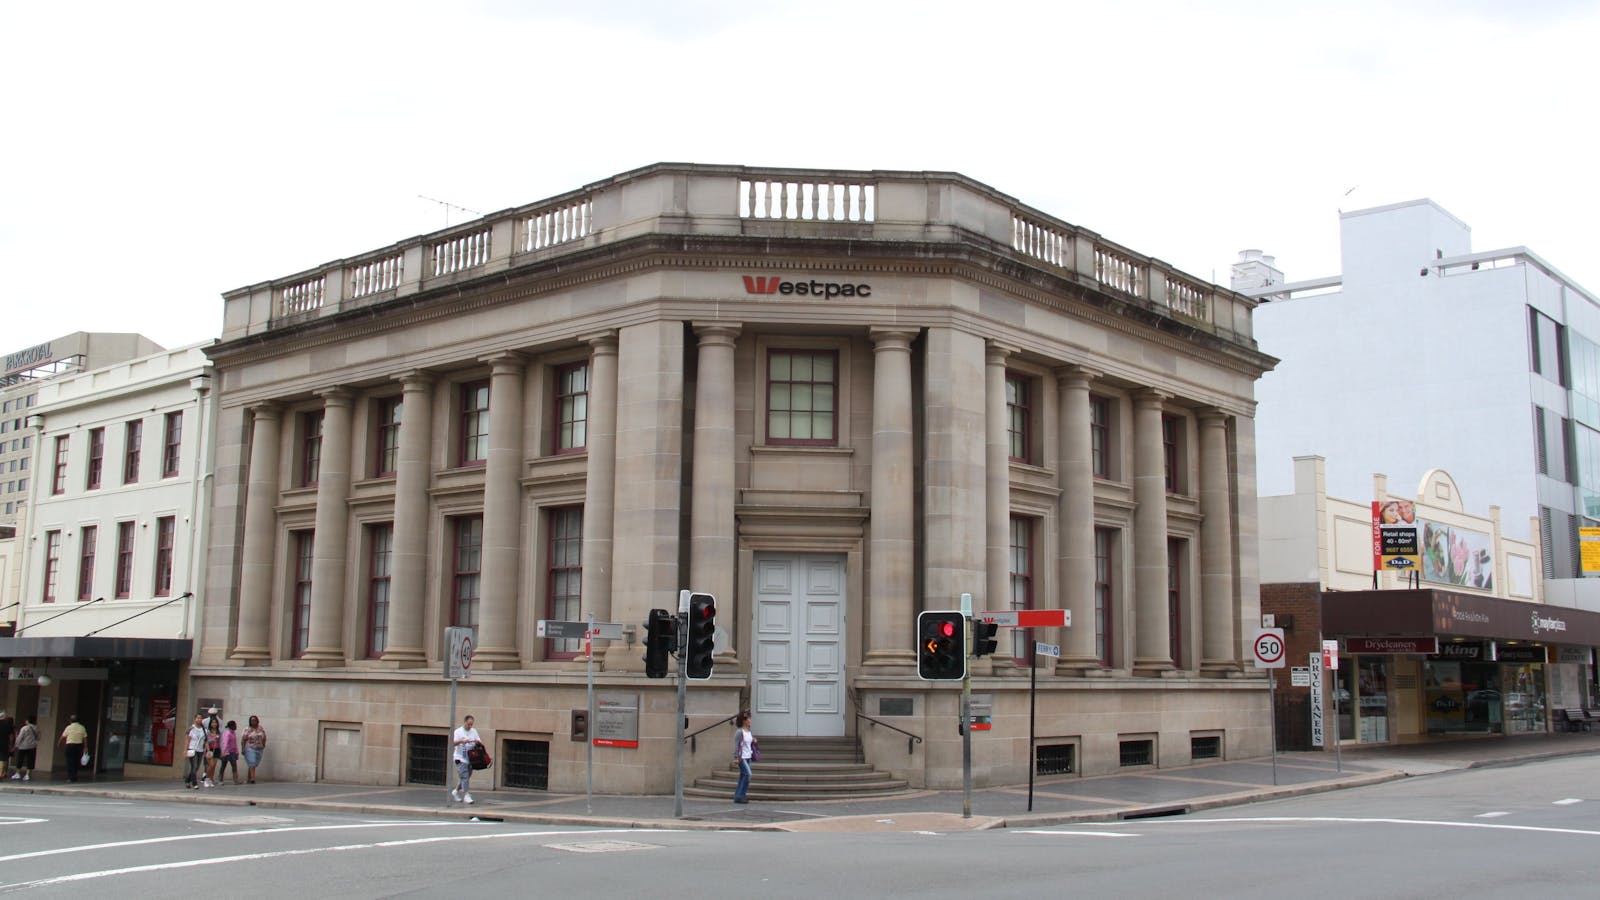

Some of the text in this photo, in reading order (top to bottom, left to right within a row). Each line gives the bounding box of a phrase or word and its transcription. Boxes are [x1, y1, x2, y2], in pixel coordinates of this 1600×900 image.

[742, 274, 872, 301] Westpac
[6, 342, 53, 371] PARKROYAL
[1373, 517, 1382, 556] FOR LEASE
[1260, 641, 1279, 655] 50
[1365, 640, 1417, 651] Drycleaners
[1443, 644, 1480, 658] King
[1311, 656, 1322, 744] DRYCLEANERS
